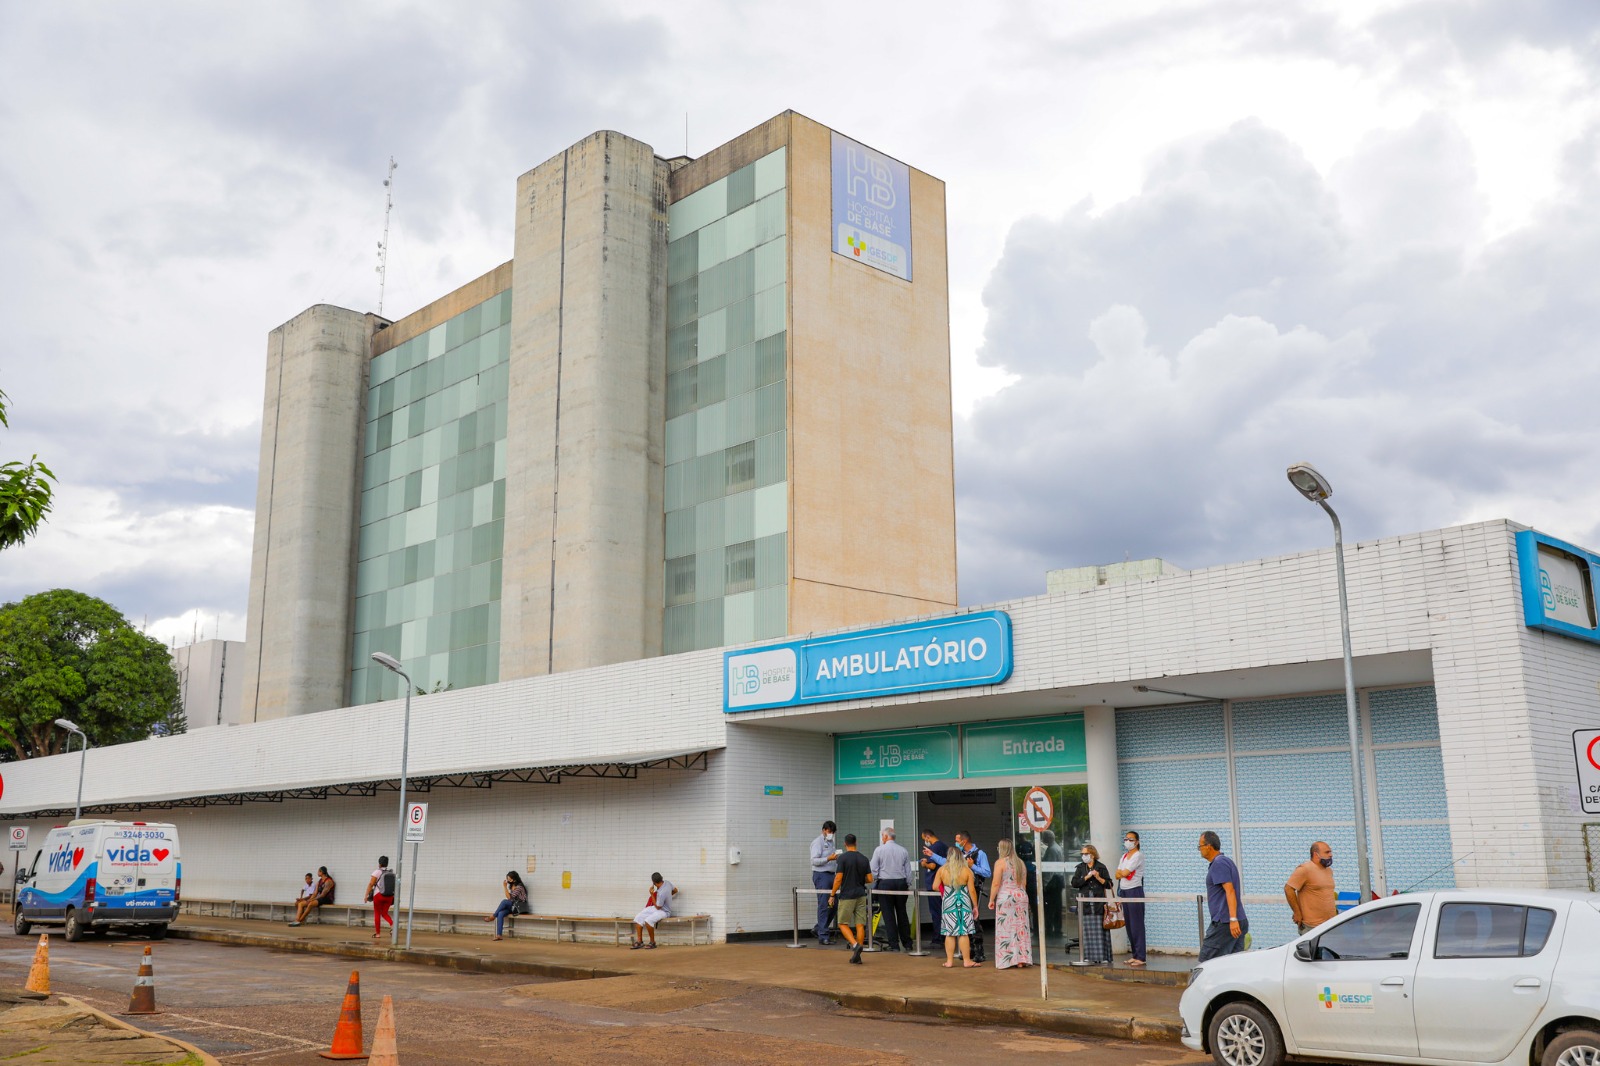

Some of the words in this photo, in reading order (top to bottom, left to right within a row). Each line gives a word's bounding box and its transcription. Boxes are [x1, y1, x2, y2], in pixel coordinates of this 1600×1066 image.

[847, 200, 896, 229] HOSPITAL
[847, 211, 862, 226] DE
[864, 218, 892, 238] BASE
[867, 244, 898, 264] IGESDF
[1554, 583, 1580, 600] HOSPITAL
[1555, 593, 1564, 604] DE
[1564, 596, 1579, 609] BASE
[816, 637, 988, 681] AMBULATÓRIO
[762, 666, 795, 678] HOSPITAL
[762, 676, 772, 685] DE
[773, 674, 790, 683] BASE
[1002, 736, 1065, 756] Entrada
[1585, 795, 1600, 804] DE
[414, 810, 419, 820] E
[1032, 797, 1046, 822] E
[48, 842, 73, 873] vida
[106, 844, 150, 862] vida
[1338, 994, 1372, 1003] IGESDF
